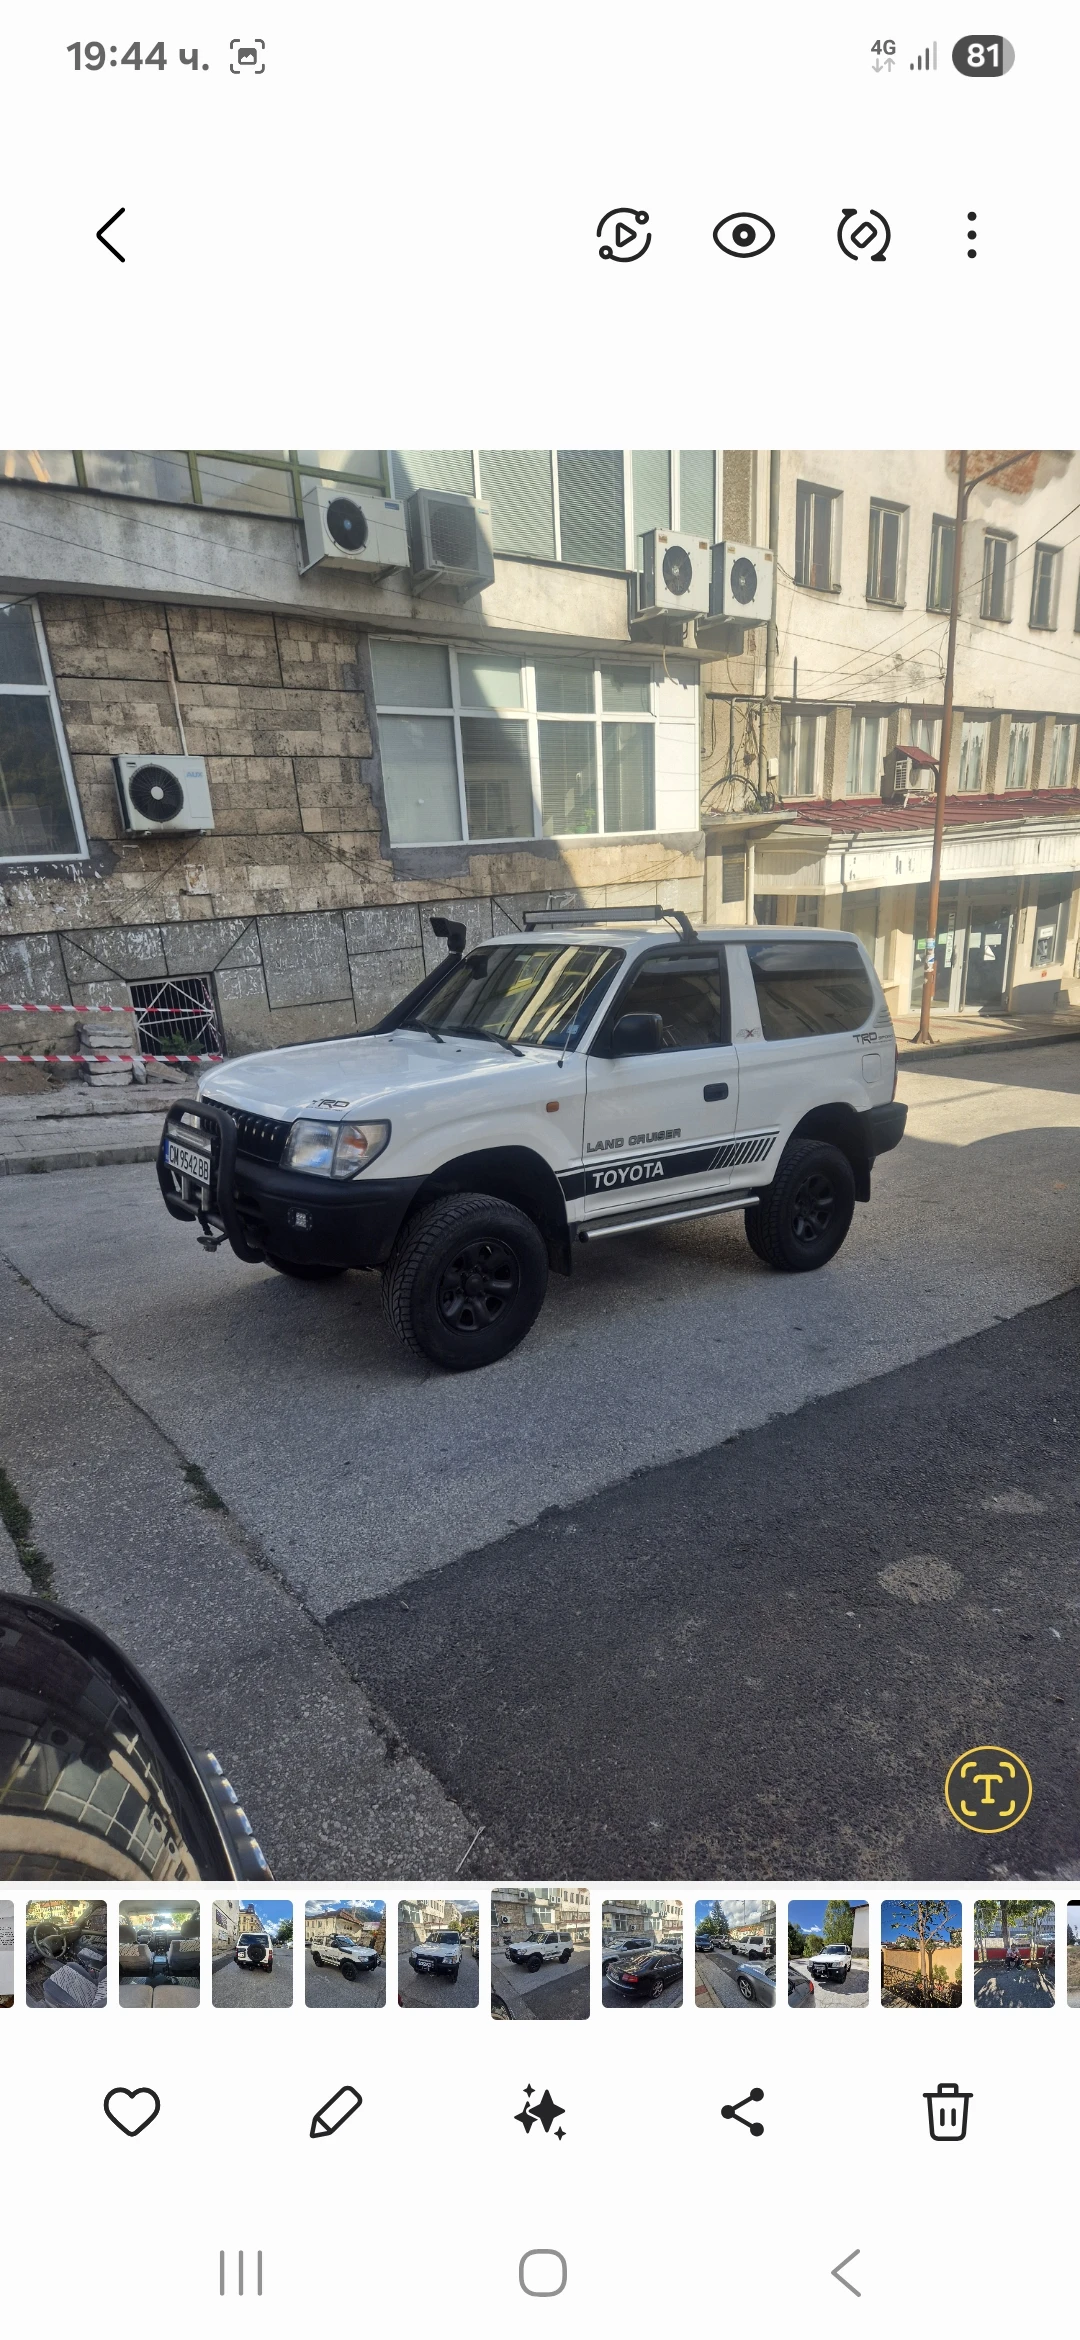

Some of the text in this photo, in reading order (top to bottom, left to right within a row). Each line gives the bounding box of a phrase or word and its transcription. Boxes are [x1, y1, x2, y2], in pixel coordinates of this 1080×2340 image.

[66, 41, 210, 71] 19:44 ч.
[870, 39, 897, 55] 4G
[967, 42, 999, 68] 81
[852, 1031, 878, 1045] TRD
[587, 1128, 682, 1153] LAND CRUISER
[592, 1161, 664, 1189] TOYOTA
